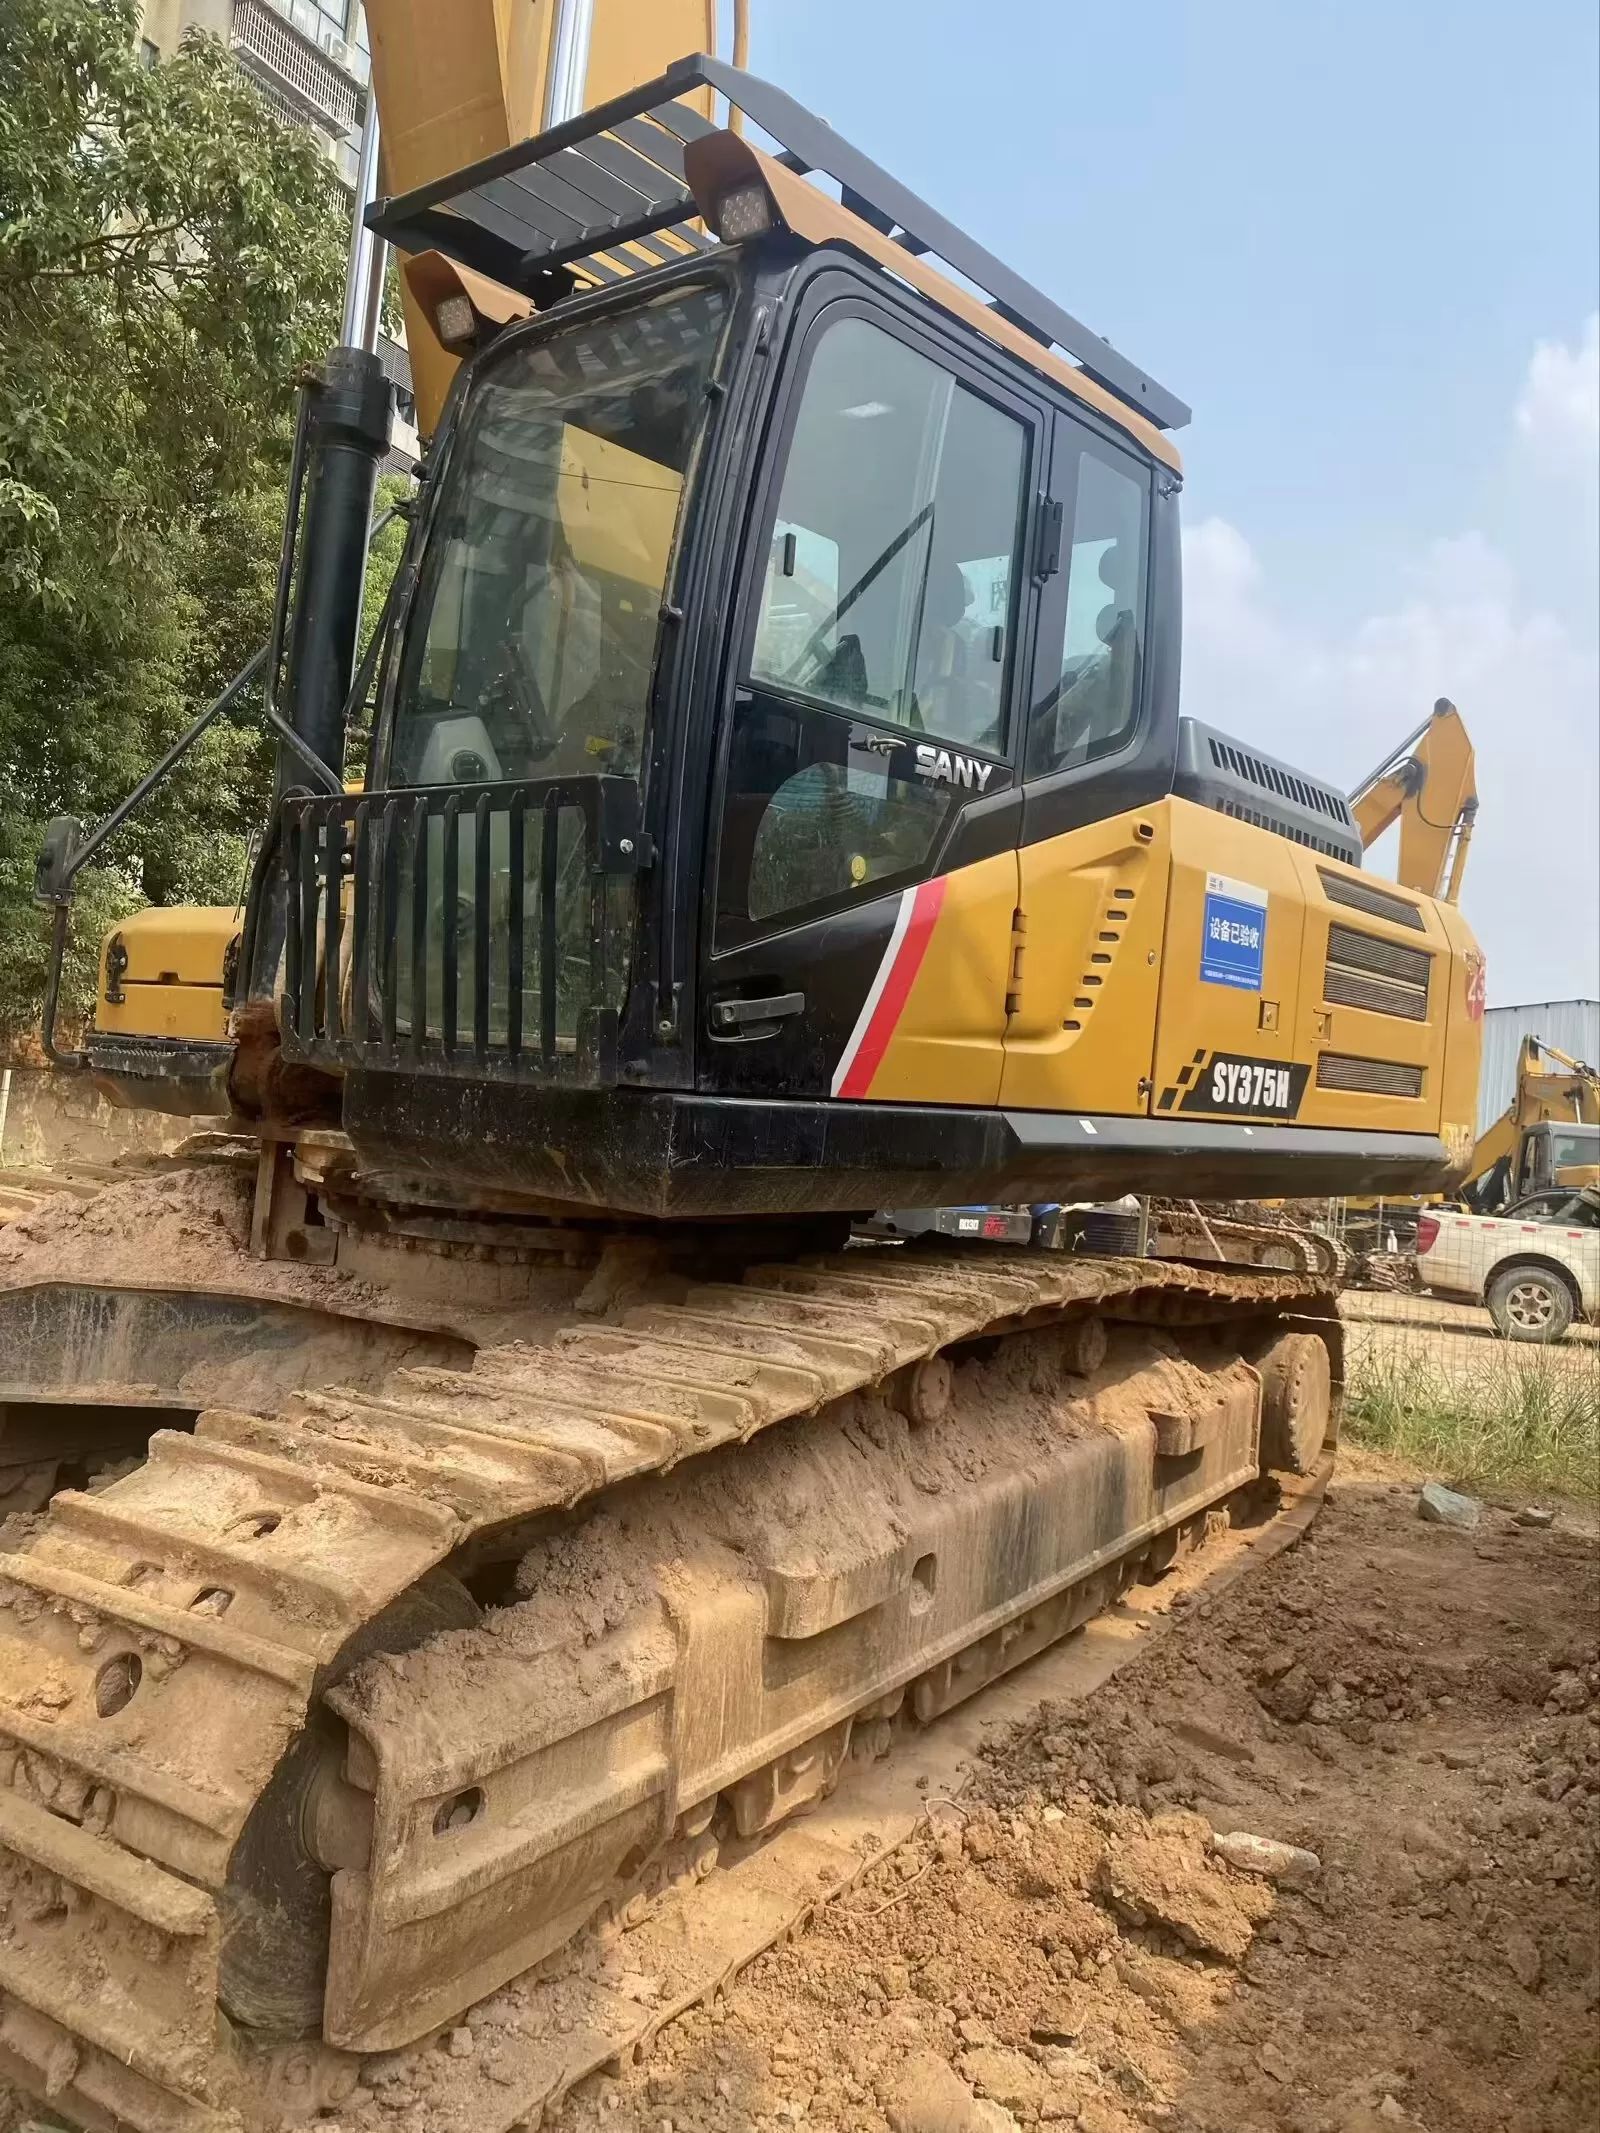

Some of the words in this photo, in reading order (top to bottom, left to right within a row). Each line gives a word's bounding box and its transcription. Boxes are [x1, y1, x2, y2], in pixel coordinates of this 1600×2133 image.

[915, 744, 993, 792] SANY
[1209, 916, 1260, 949] 设备已验收
[1212, 1062, 1290, 1108] SY375H
